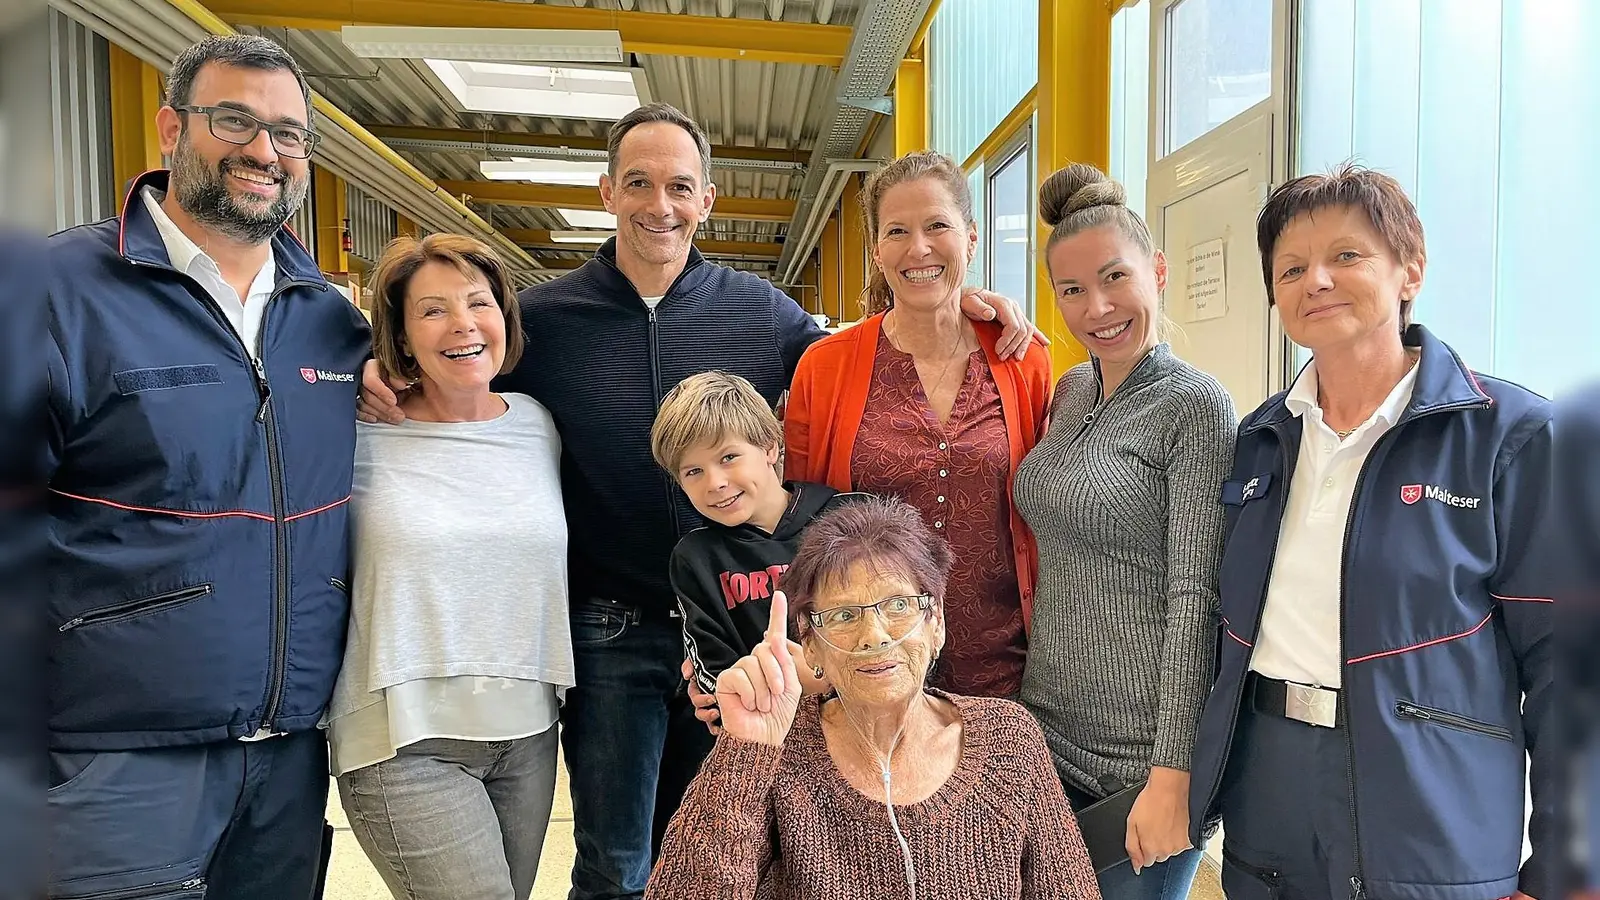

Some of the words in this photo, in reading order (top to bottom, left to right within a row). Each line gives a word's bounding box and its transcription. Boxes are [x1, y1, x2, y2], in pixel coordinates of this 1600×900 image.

[316, 370, 354, 382] Malteser
[1425, 485, 1480, 508] Malteser
[720, 565, 789, 610] FORT
